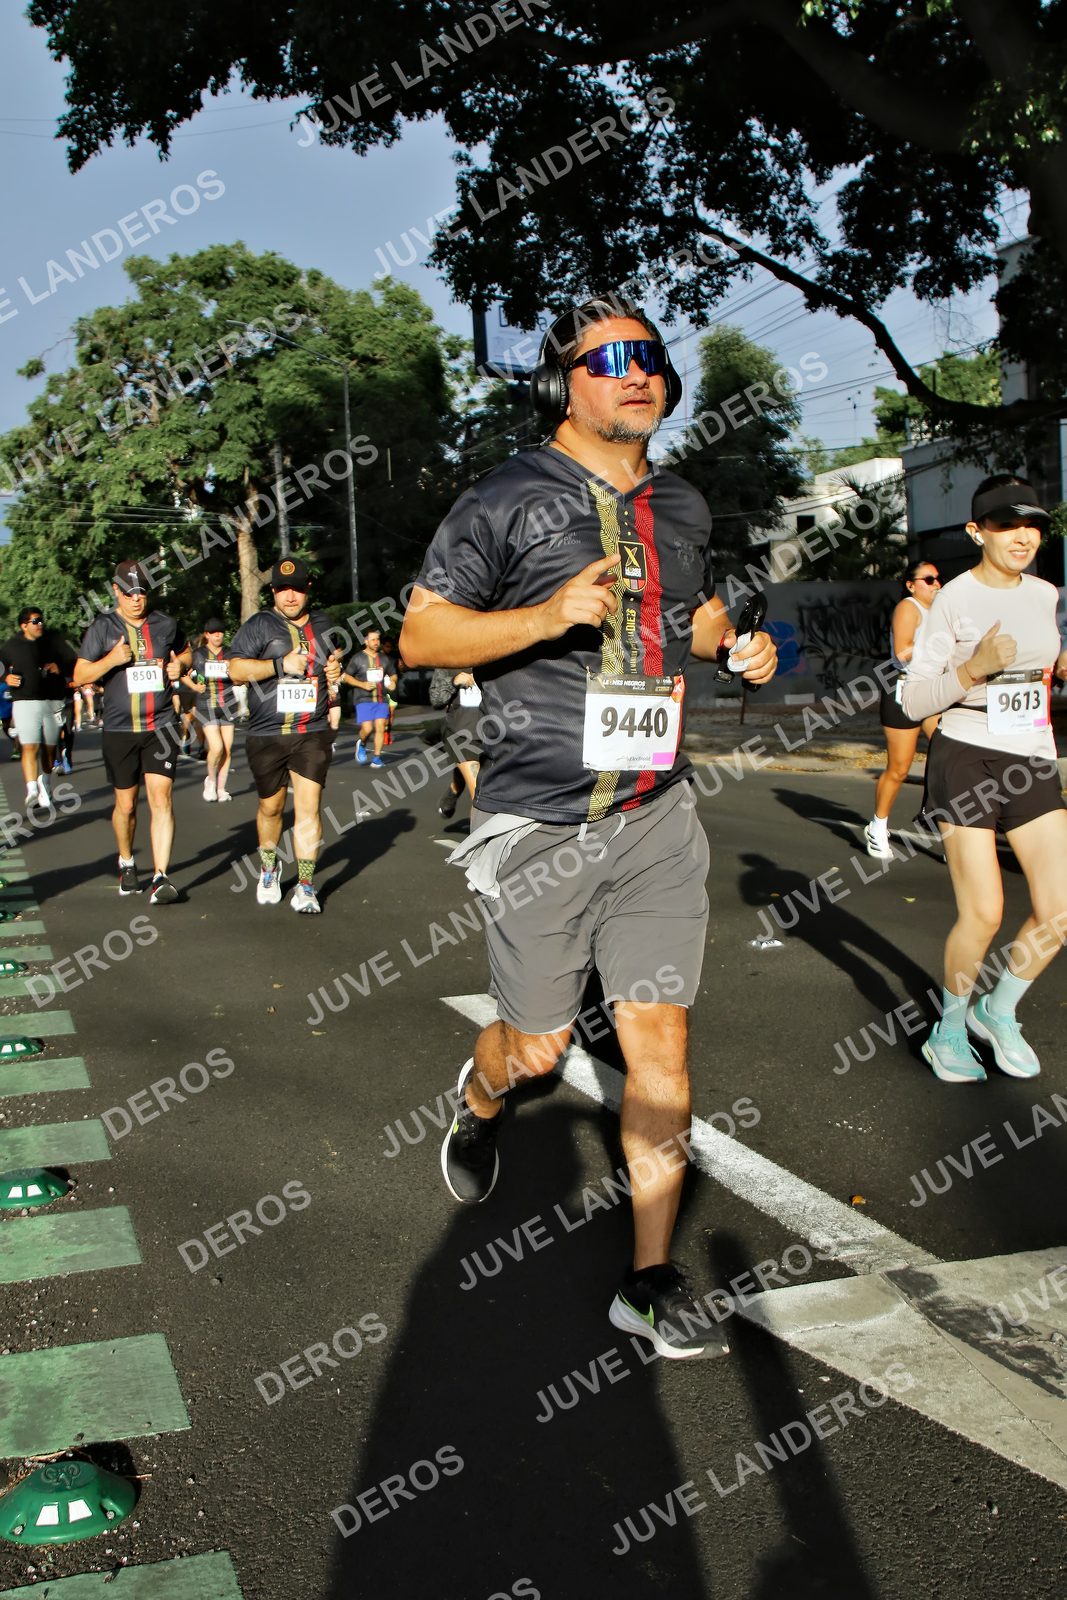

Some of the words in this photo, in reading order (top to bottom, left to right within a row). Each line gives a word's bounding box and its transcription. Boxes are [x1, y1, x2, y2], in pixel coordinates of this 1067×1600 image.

[132, 670, 157, 681] 8501
[281, 688, 314, 700] 11874
[998, 690, 1041, 713] 9613
[601, 706, 669, 738] 9440
